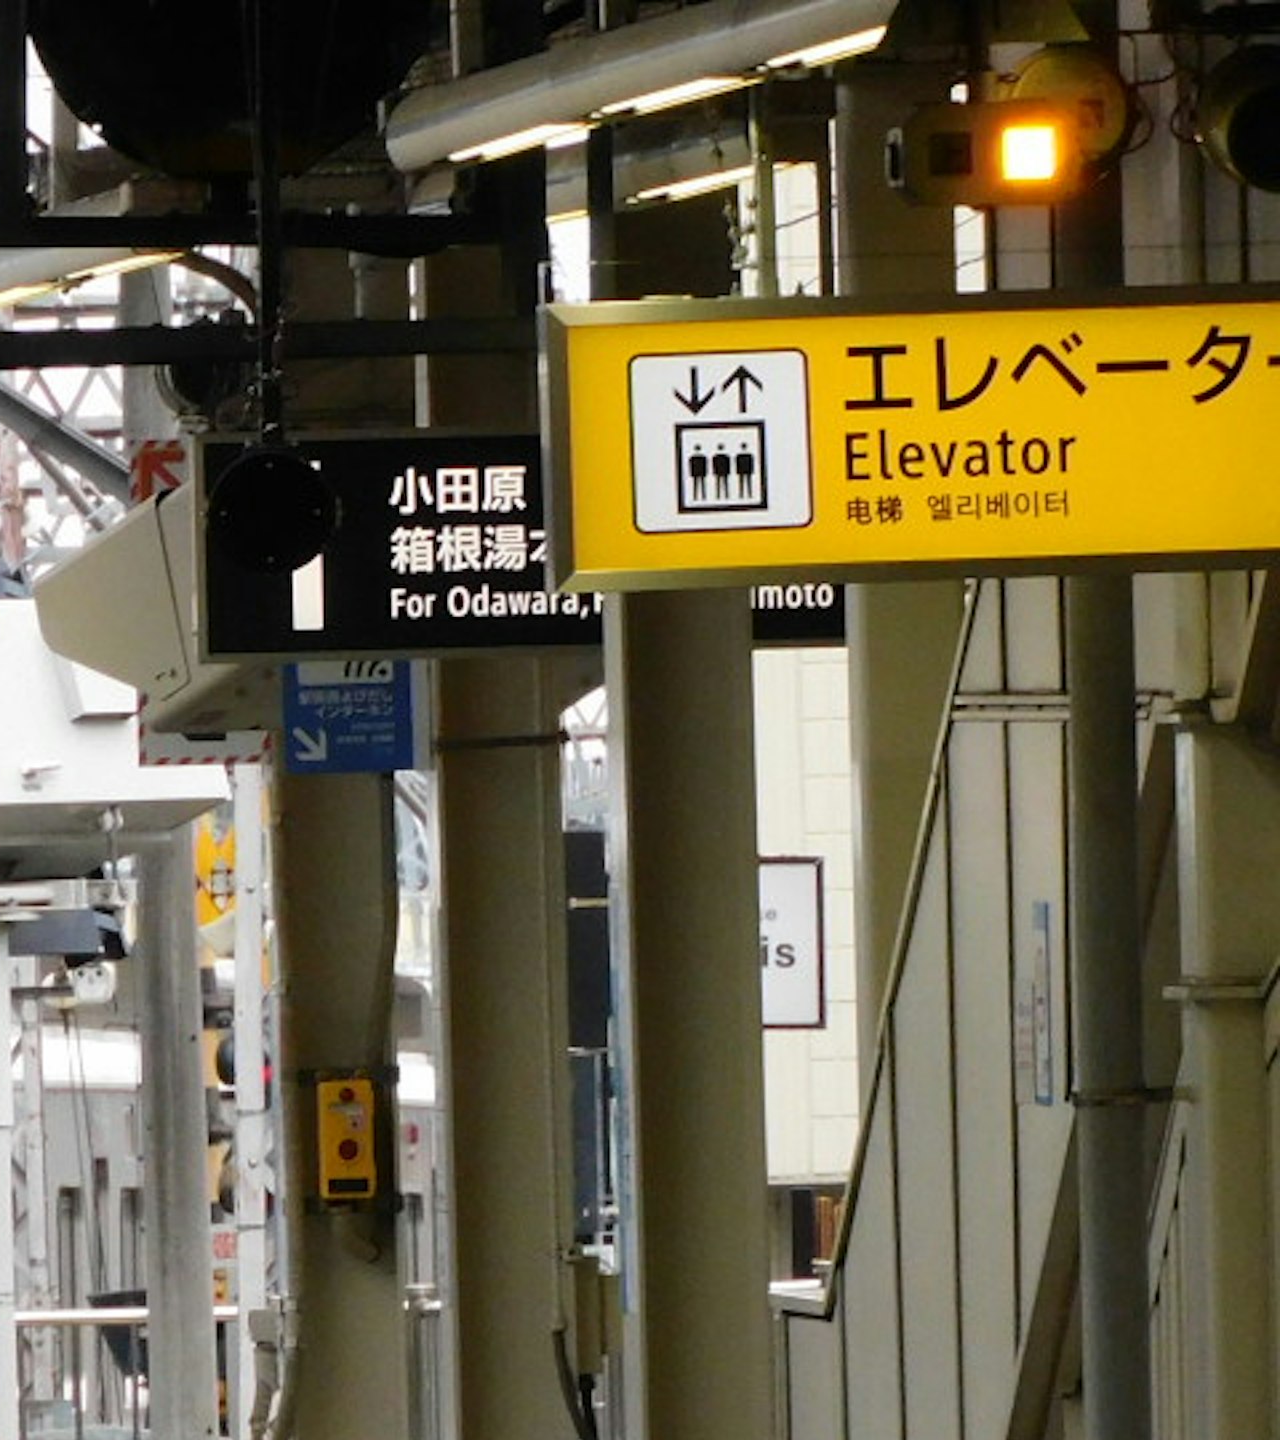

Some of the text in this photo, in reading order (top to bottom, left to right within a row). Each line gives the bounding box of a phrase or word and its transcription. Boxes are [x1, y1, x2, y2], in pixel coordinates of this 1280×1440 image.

[844, 429, 1078, 481] Elevator
[389, 466, 528, 515] 小田原
[846, 490, 1069, 524] 电梯 엘리베이터
[390, 588, 436, 619] For
